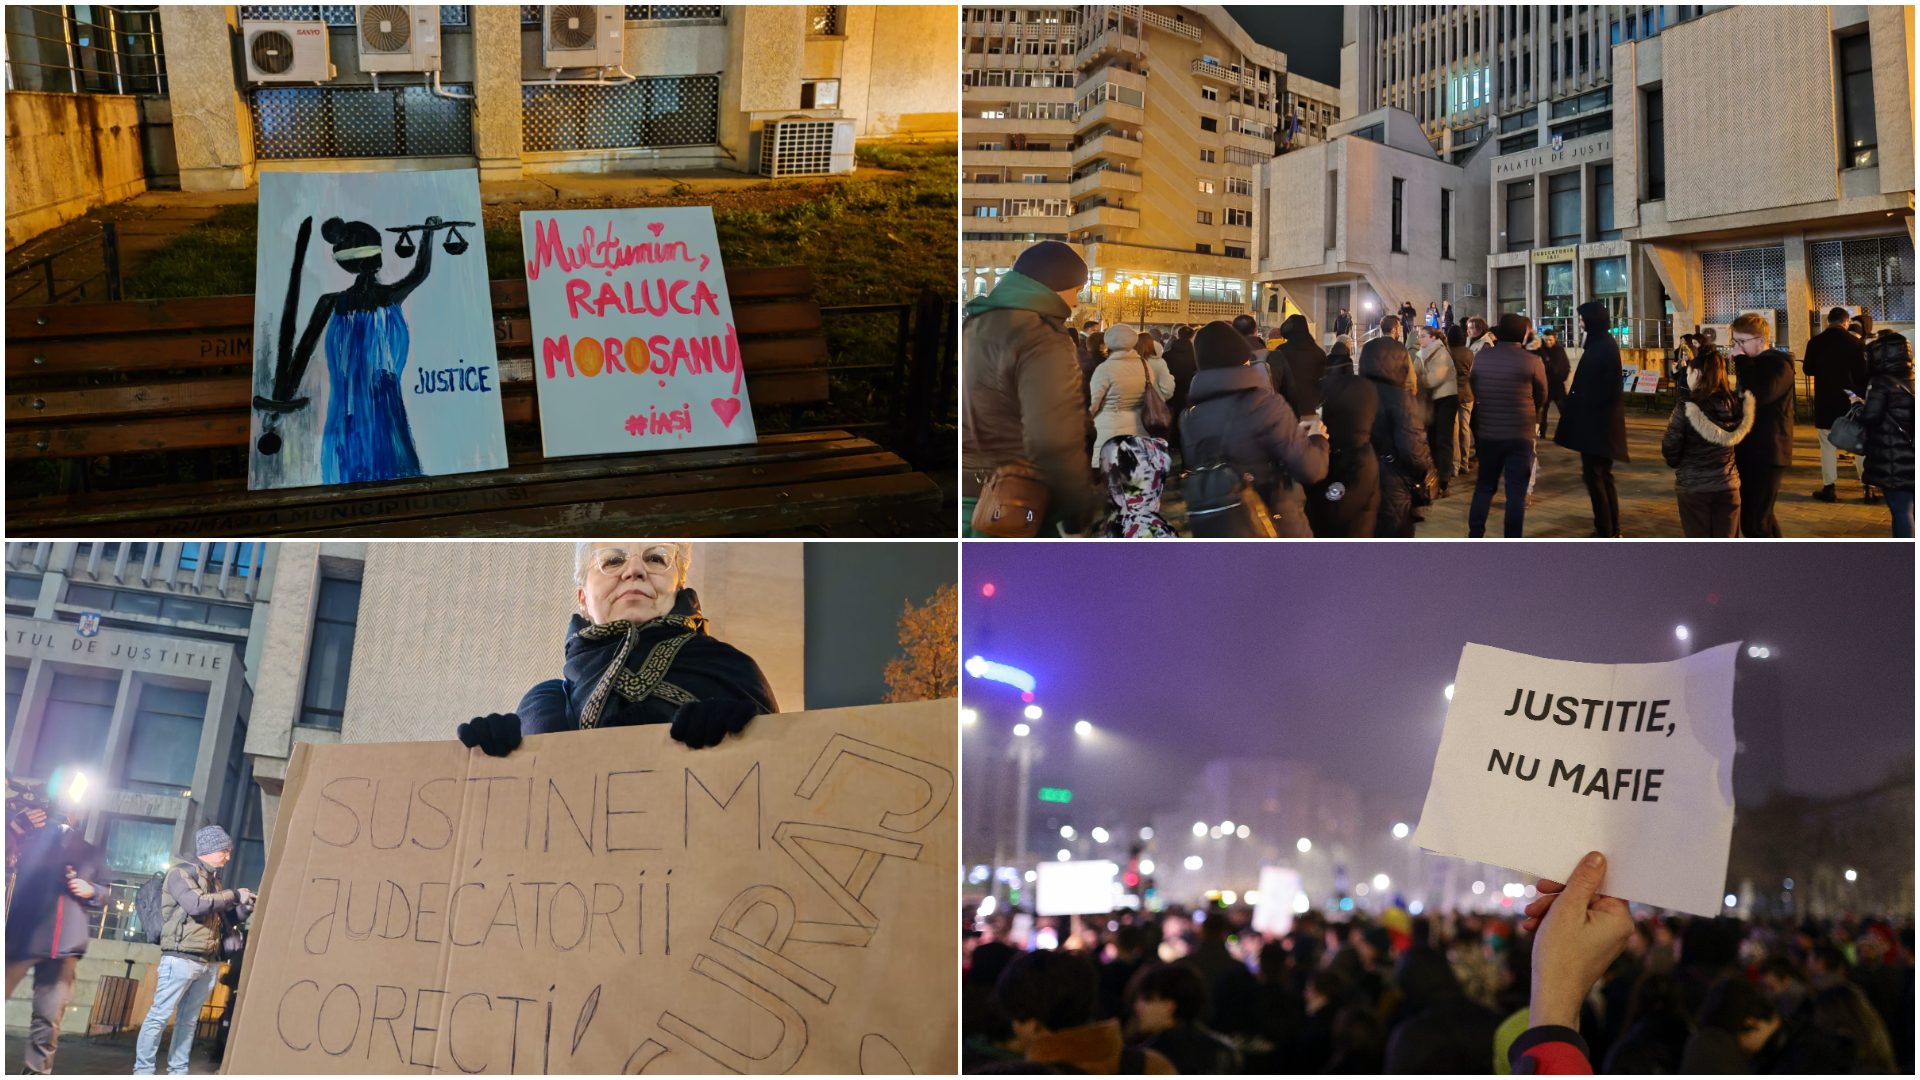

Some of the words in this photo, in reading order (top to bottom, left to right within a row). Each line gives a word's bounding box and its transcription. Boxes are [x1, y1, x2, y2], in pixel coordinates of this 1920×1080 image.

[1497, 157, 1543, 173] PALATUL
[1551, 151, 1565, 162] DE
[565, 277, 720, 319] RALUCA
[72, 638, 97, 652] DE
[111, 643, 223, 671] JUSTITIE
[1503, 687, 1677, 738] JUSTITIE,
[1487, 748, 1541, 782] NU
[1547, 758, 1666, 803] MAFIE
